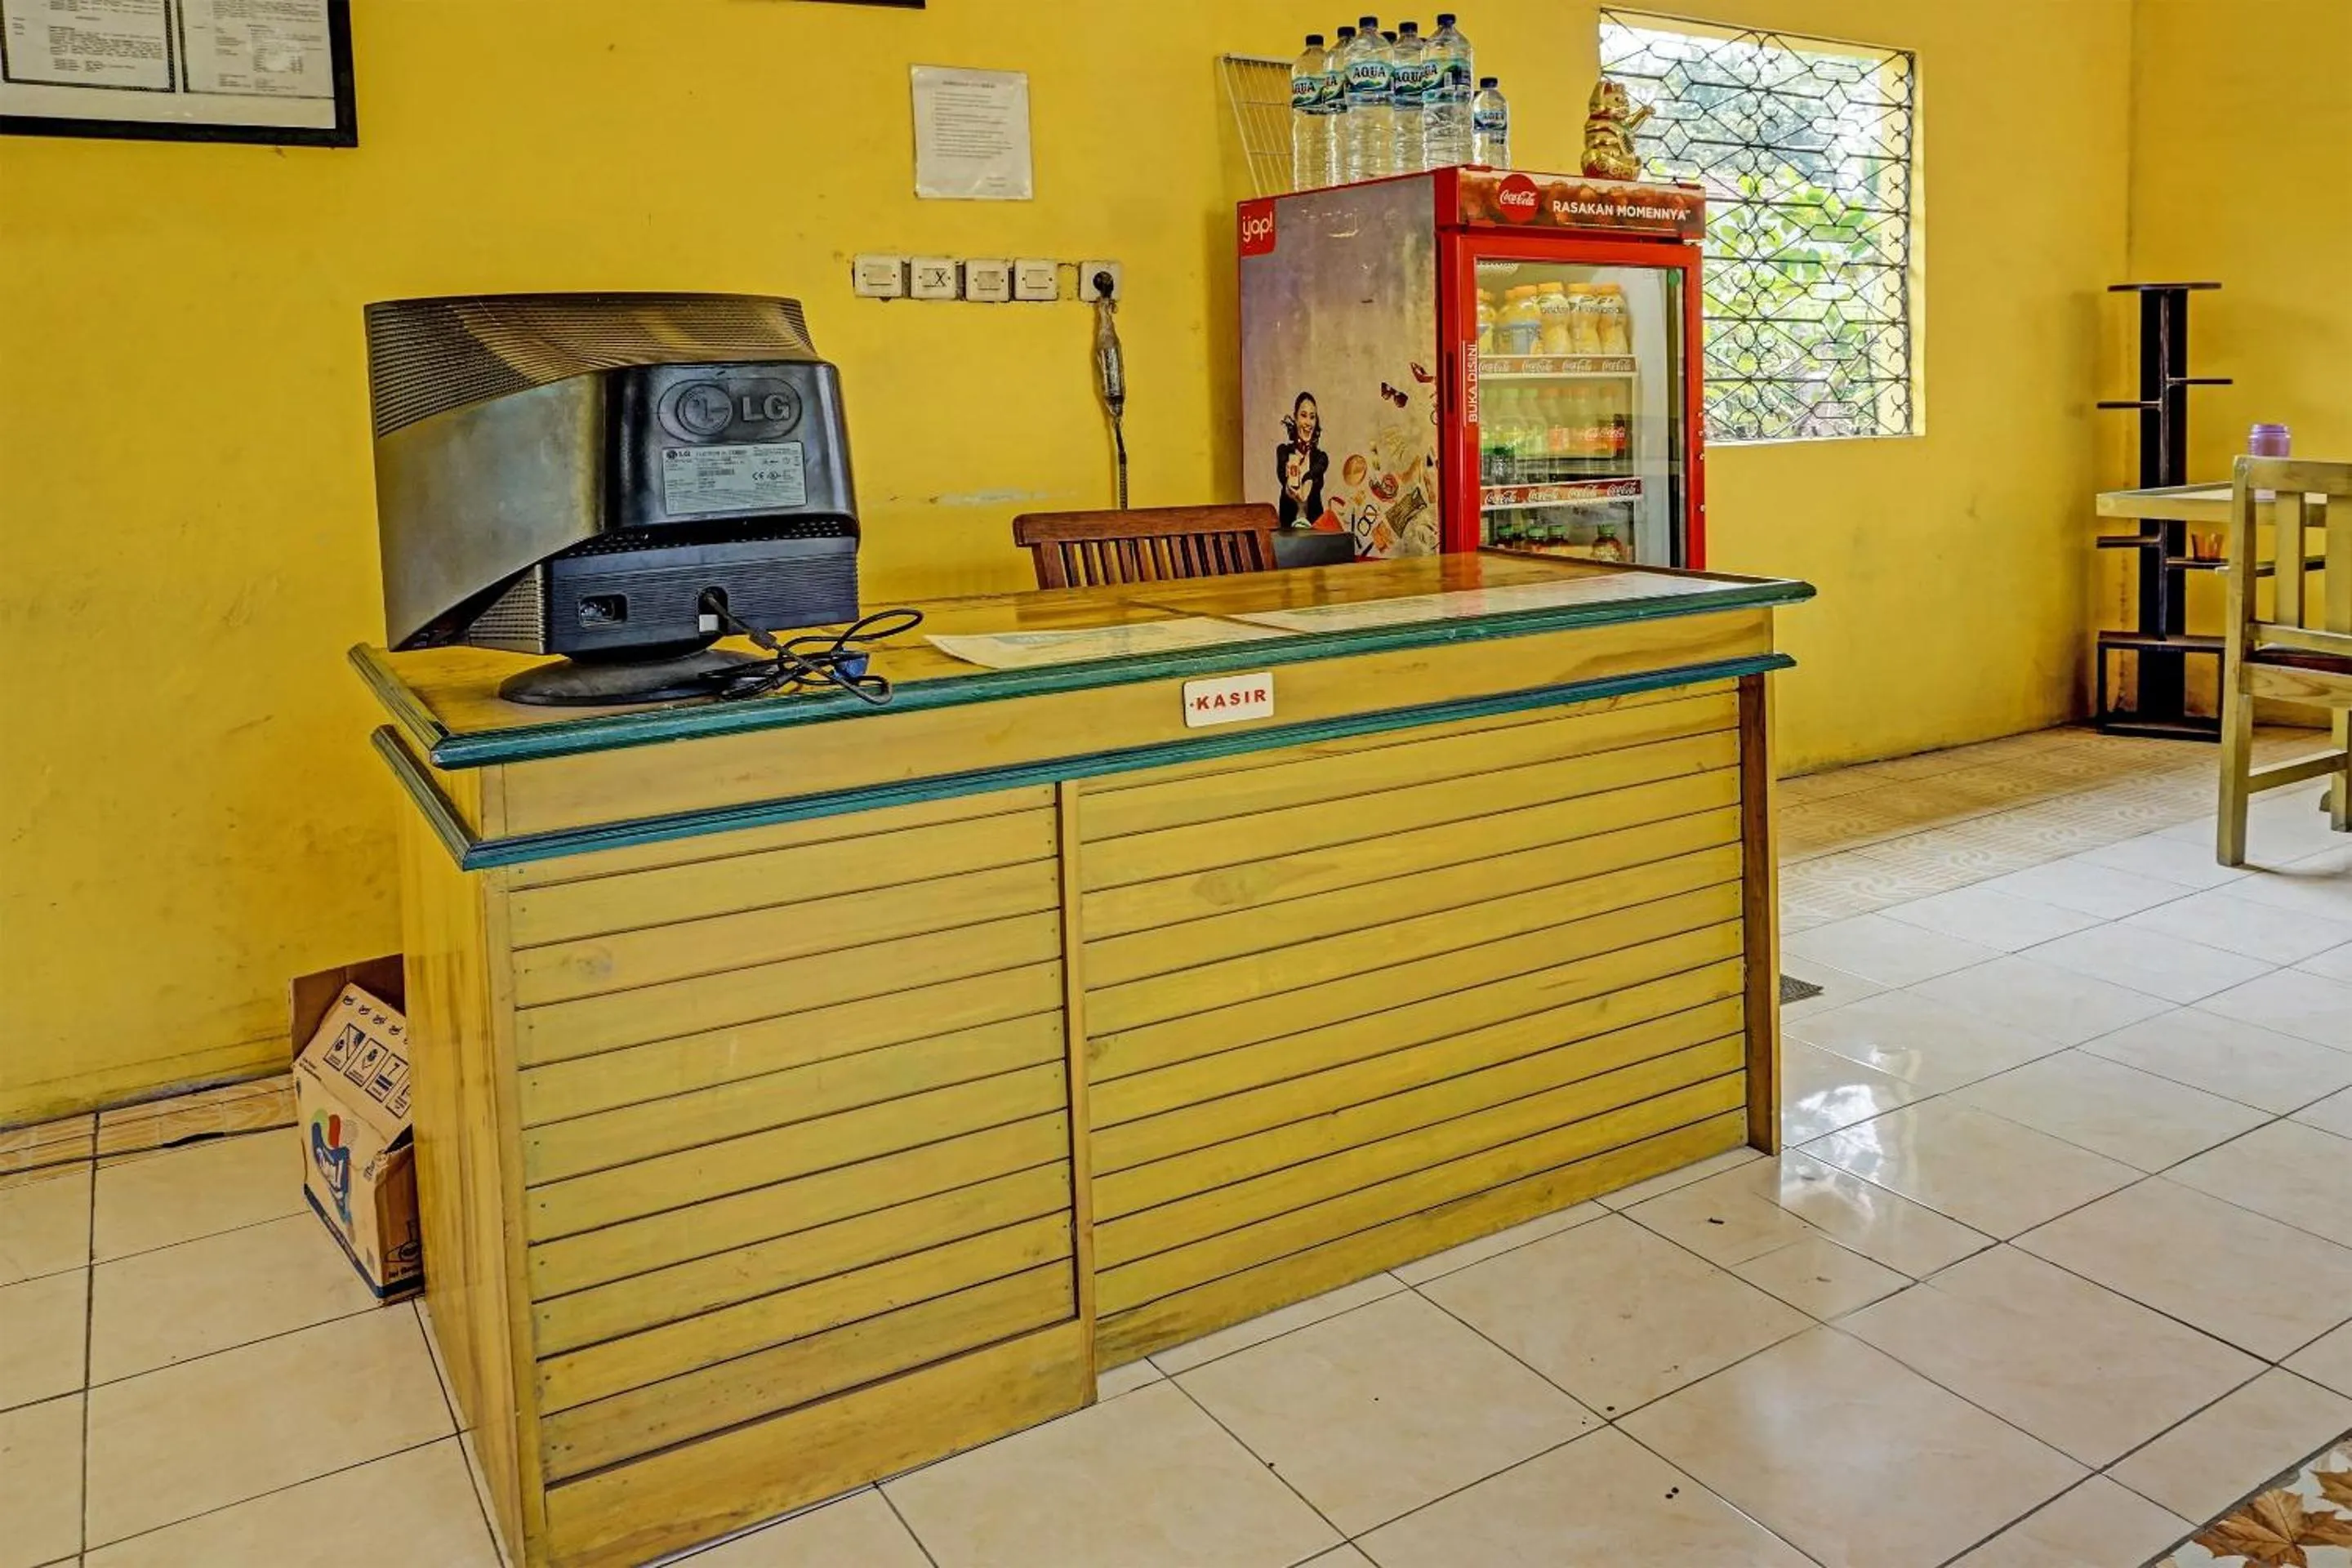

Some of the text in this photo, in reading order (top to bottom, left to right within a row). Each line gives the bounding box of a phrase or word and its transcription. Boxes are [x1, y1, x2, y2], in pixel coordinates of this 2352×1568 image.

[1353, 66, 1386, 79] AQUA
[1500, 189, 1536, 206] Coca-Cola
[1553, 200, 1614, 216] RASAKAN
[1467, 344, 1477, 423] BUKA DISINI
[742, 395, 791, 422] LG
[1196, 688, 1267, 710] KASIR
